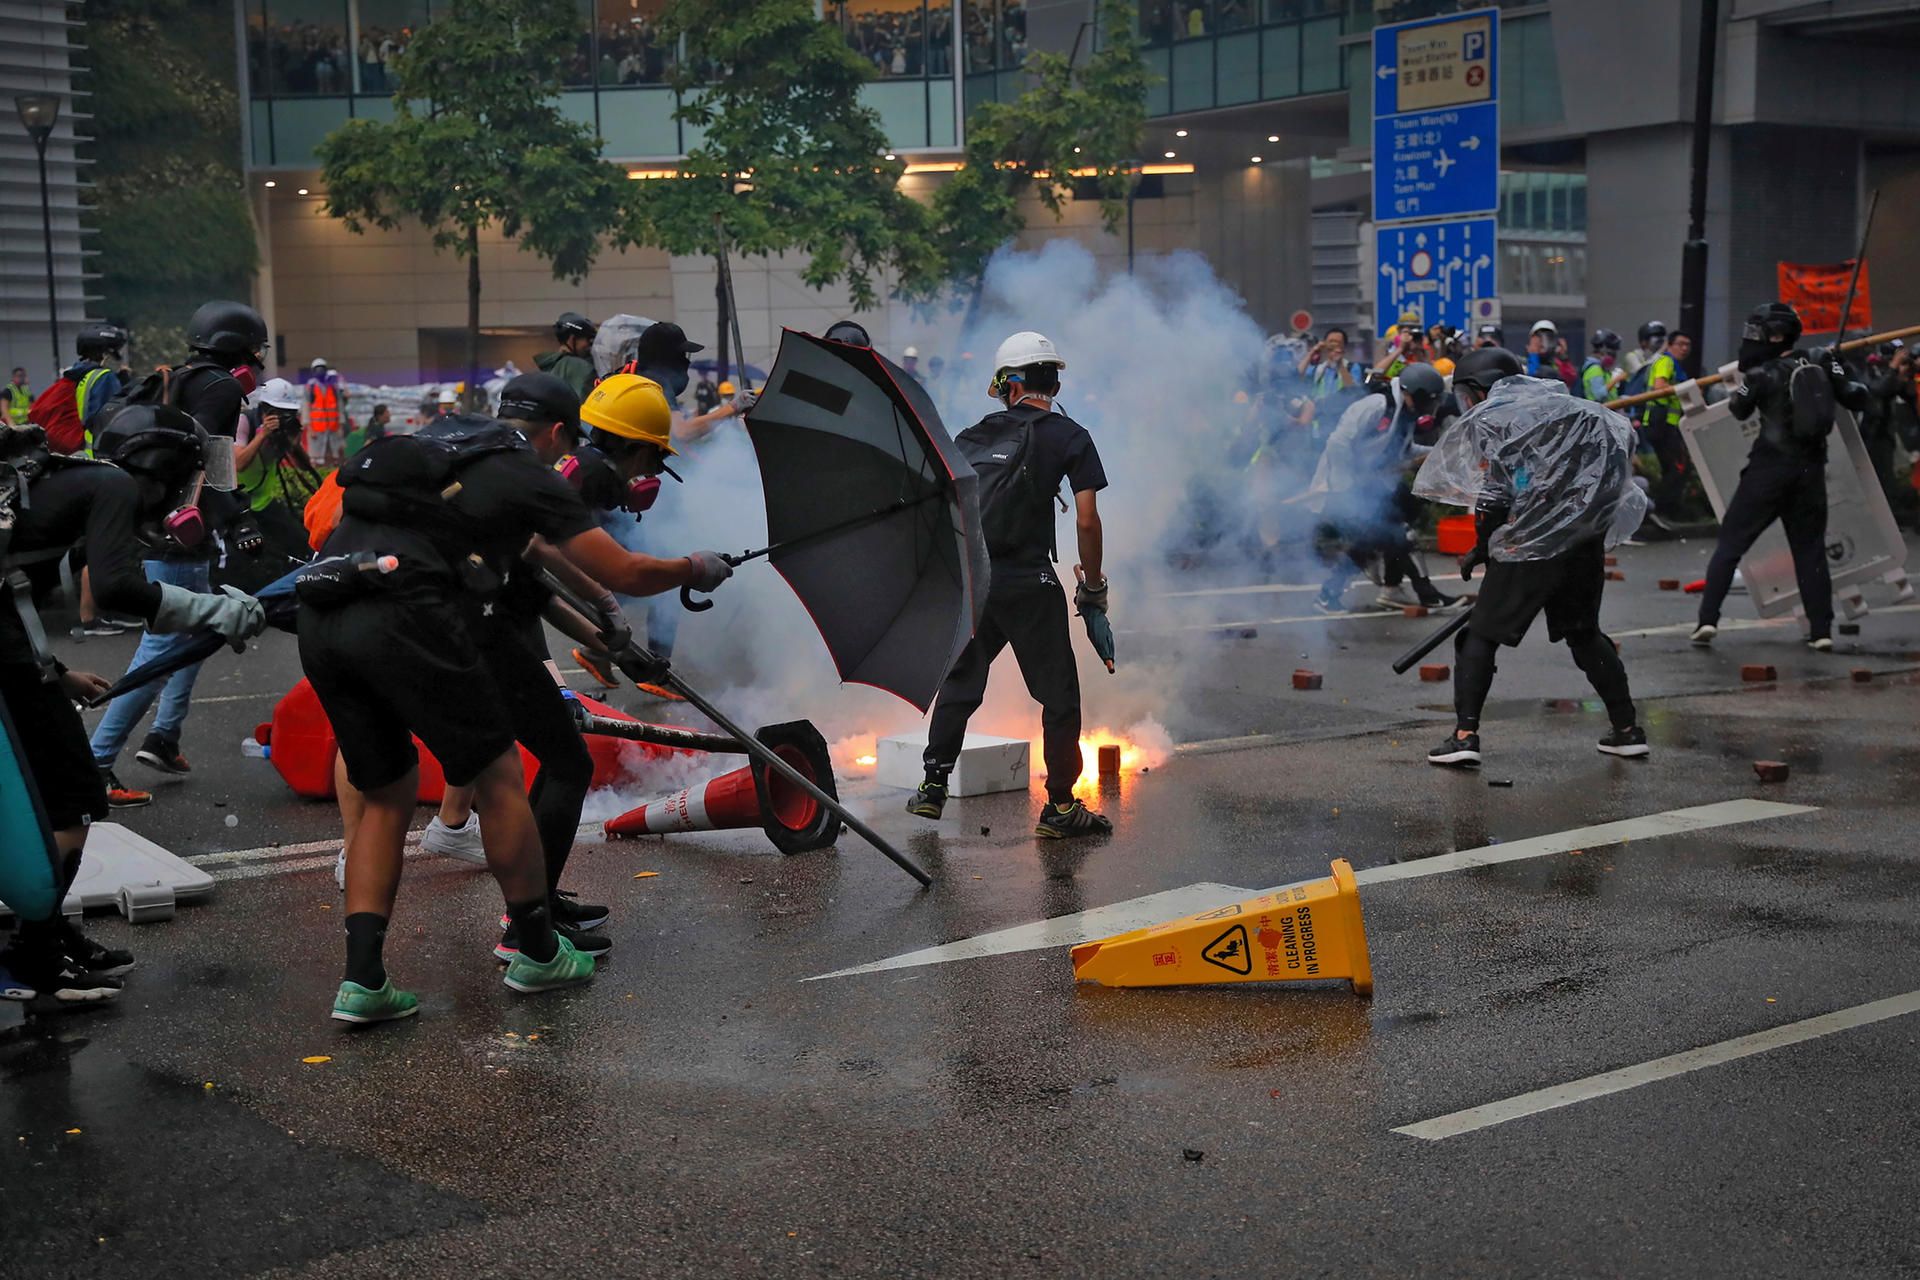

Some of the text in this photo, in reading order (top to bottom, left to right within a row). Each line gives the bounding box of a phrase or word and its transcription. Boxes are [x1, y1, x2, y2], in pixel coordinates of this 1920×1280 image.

[1281, 916, 1300, 970] CLEANING
[1296, 906, 1317, 961] PROGRESS
[1306, 962, 1320, 975] IN
